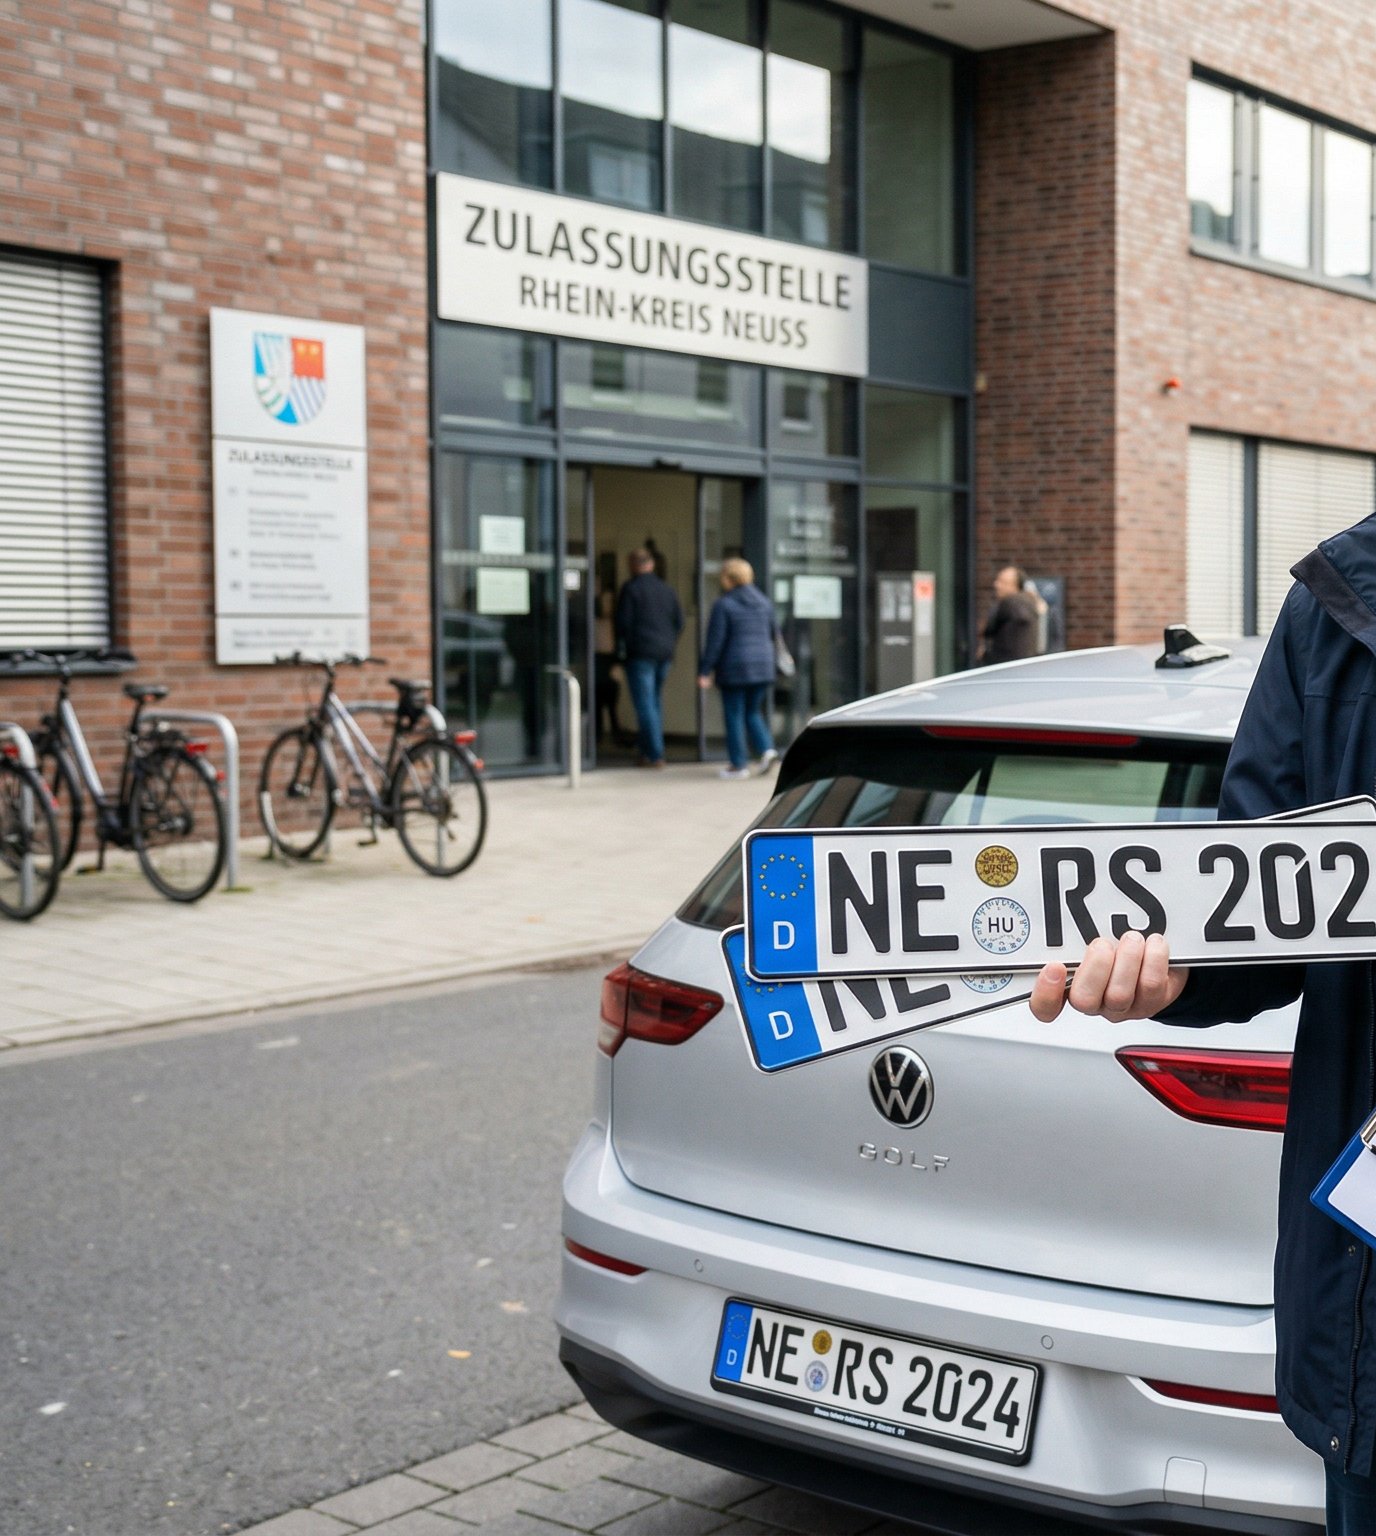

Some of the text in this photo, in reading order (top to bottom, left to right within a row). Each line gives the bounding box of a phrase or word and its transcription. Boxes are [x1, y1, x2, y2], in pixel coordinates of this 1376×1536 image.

[465, 204, 850, 311] ZULASSUNGSSTELLE
[520, 275, 808, 349] RHEIN-KREIS NEUSS
[828, 849, 960, 955] NE
[1040, 845, 1168, 947] RS
[773, 921, 795, 950] D
[988, 917, 1014, 933] HU
[768, 1010, 794, 1041] D
[858, 1142, 950, 1172] GOLF
[726, 1348, 738, 1366] D
[746, 1317, 805, 1386] NE
[832, 1338, 894, 1405] RS
[902, 1356, 1020, 1439] 2024
